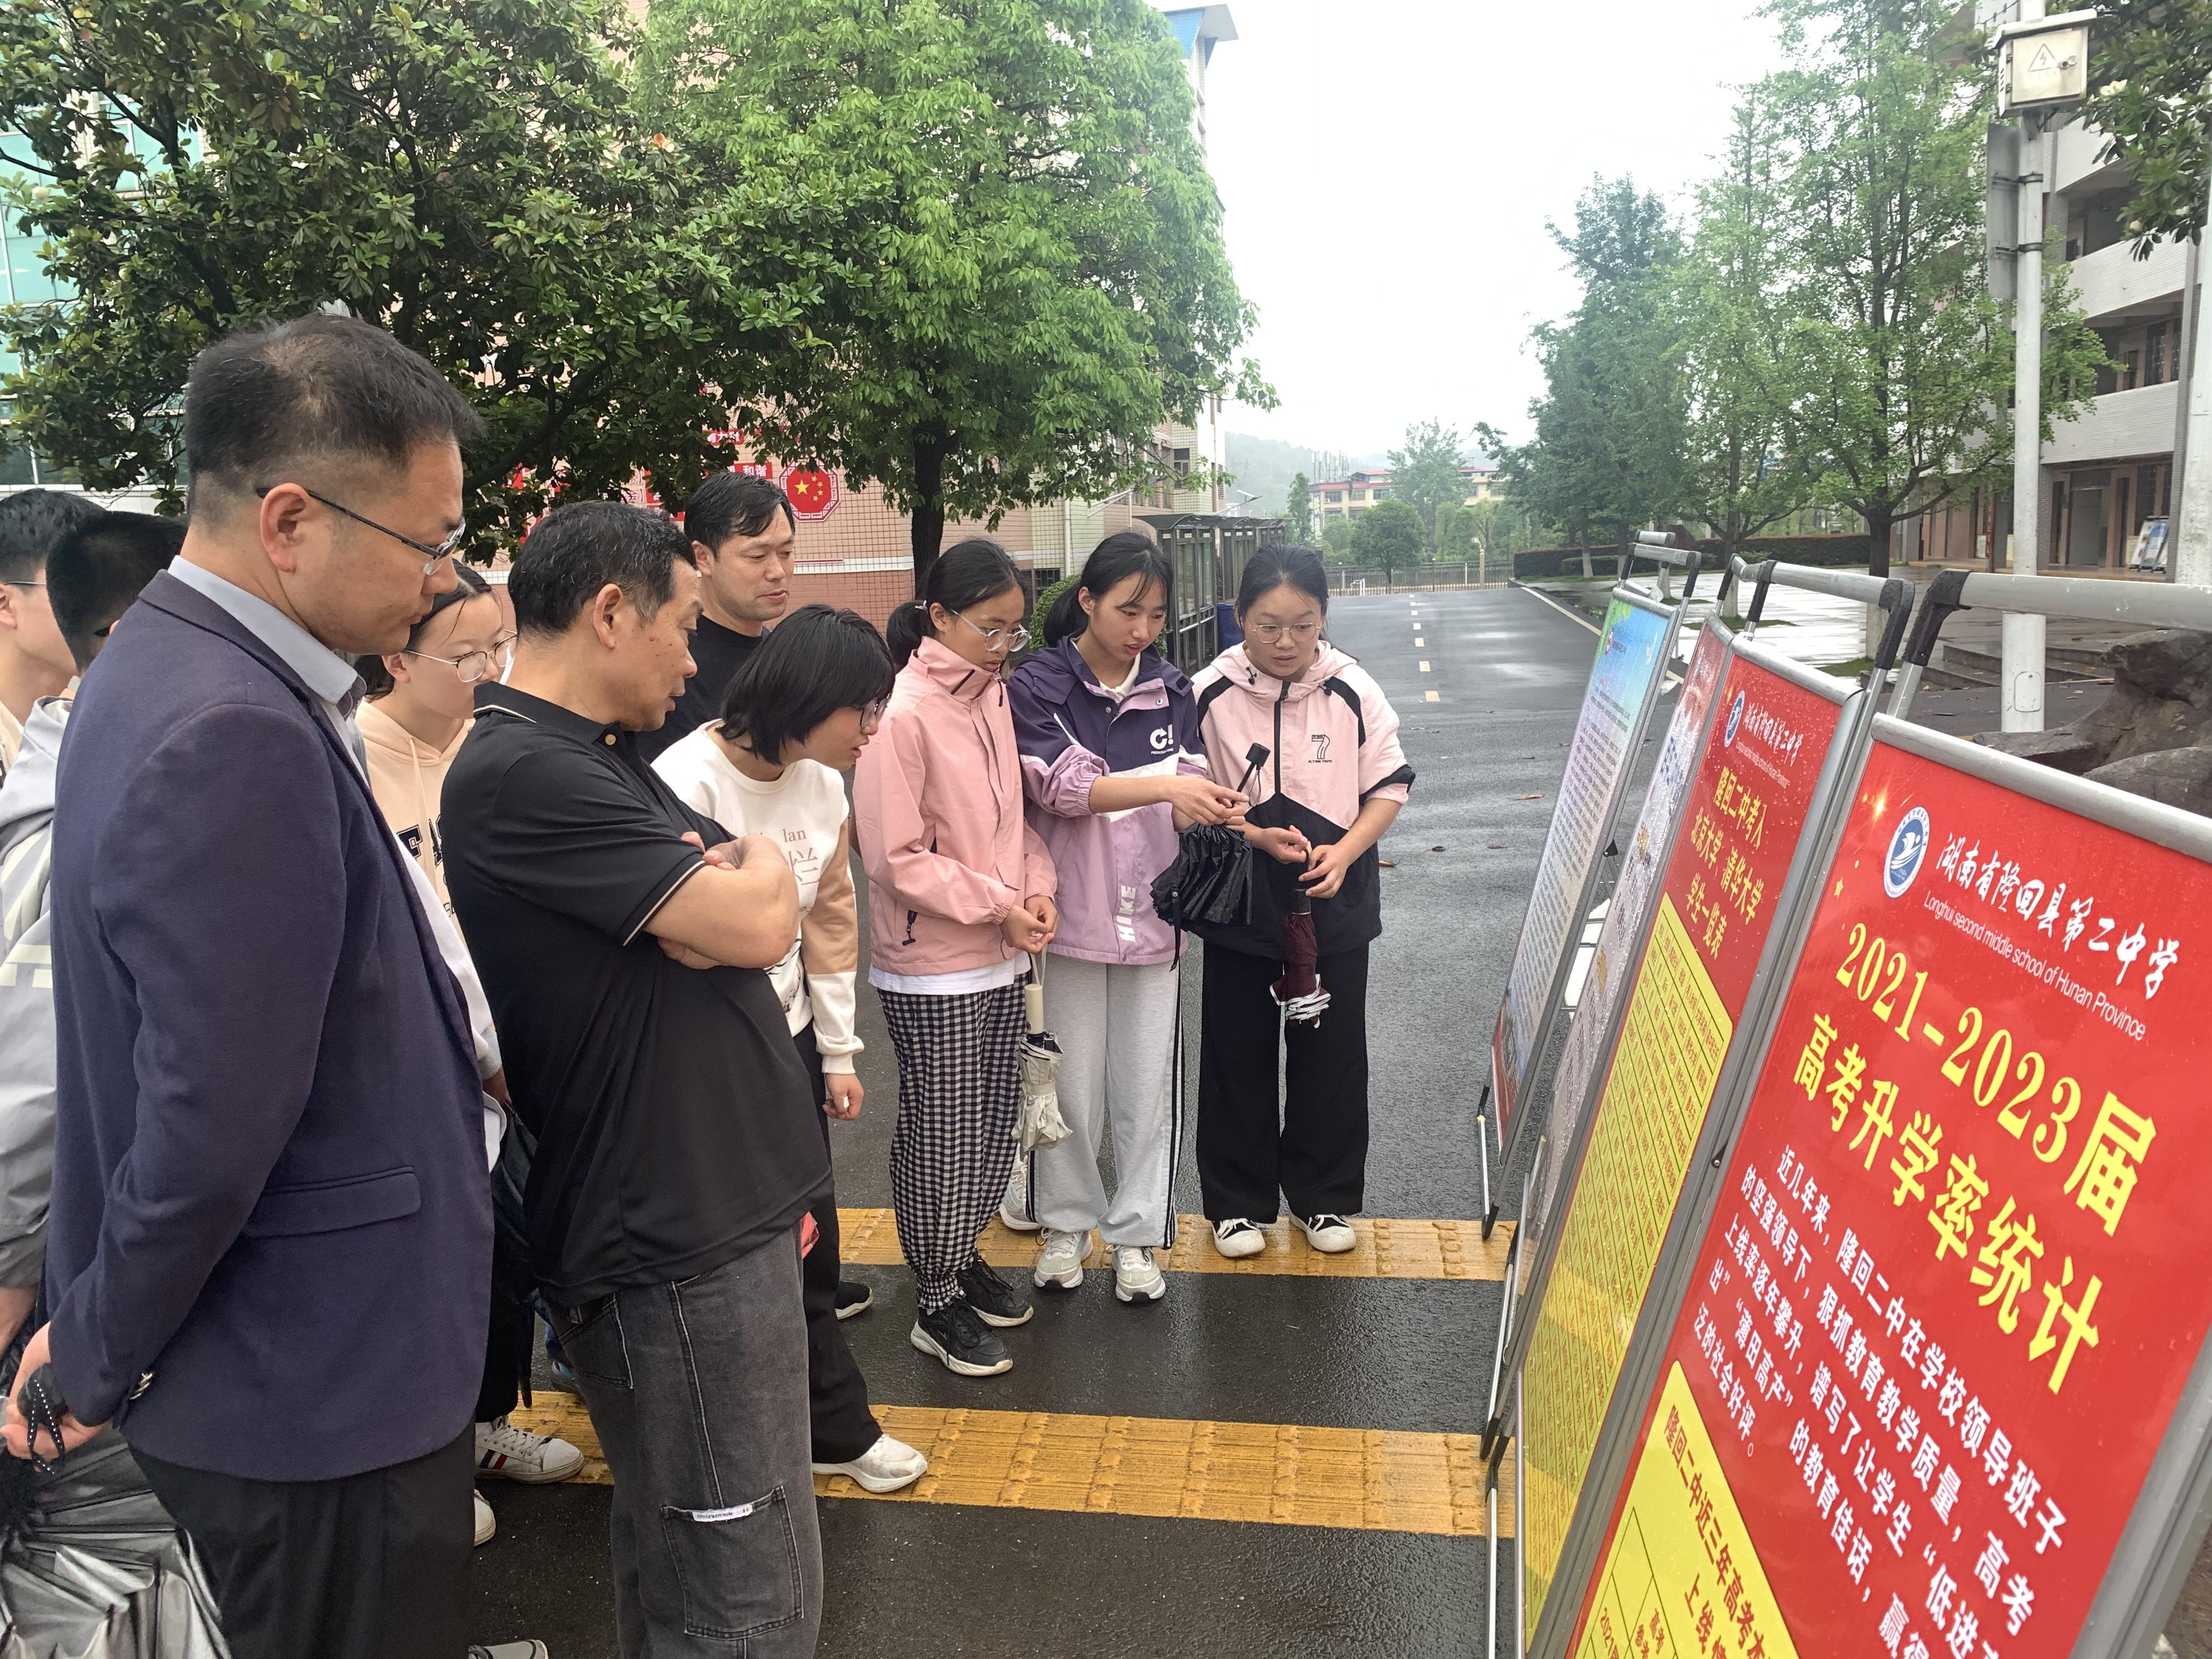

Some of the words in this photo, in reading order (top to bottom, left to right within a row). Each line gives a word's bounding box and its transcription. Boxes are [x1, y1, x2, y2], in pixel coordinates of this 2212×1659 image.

[782, 828, 807, 843] lan
[1713, 765, 1767, 850] 隆回二中考入
[1116, 885, 1136, 943] HIKE
[1687, 872, 1727, 960] 学生一览表
[1924, 890, 1957, 922] Longhui
[1953, 912, 1986, 940] second
[1982, 929, 2013, 958] middle
[2012, 948, 2047, 979] school
[2044, 966, 2060, 986] of
[2055, 969, 2093, 1009] Hunan
[2091, 991, 2146, 1041] Province
[1935, 832, 2181, 1000] 湖南省隆回县第二中学
[1836, 923, 2157, 1237] 2021-2023届
[1793, 1013, 2103, 1395] 高考升学率统计
[1694, 1301, 1756, 1457] 泛的社会好评。
[1725, 1213, 1999, 1659] 上线率逐年攀升，谱写了让学生“低进
[1664, 1403, 1770, 1659] 隆回二中近三年高考本
[1650, 1607, 1664, 1655] 高考
